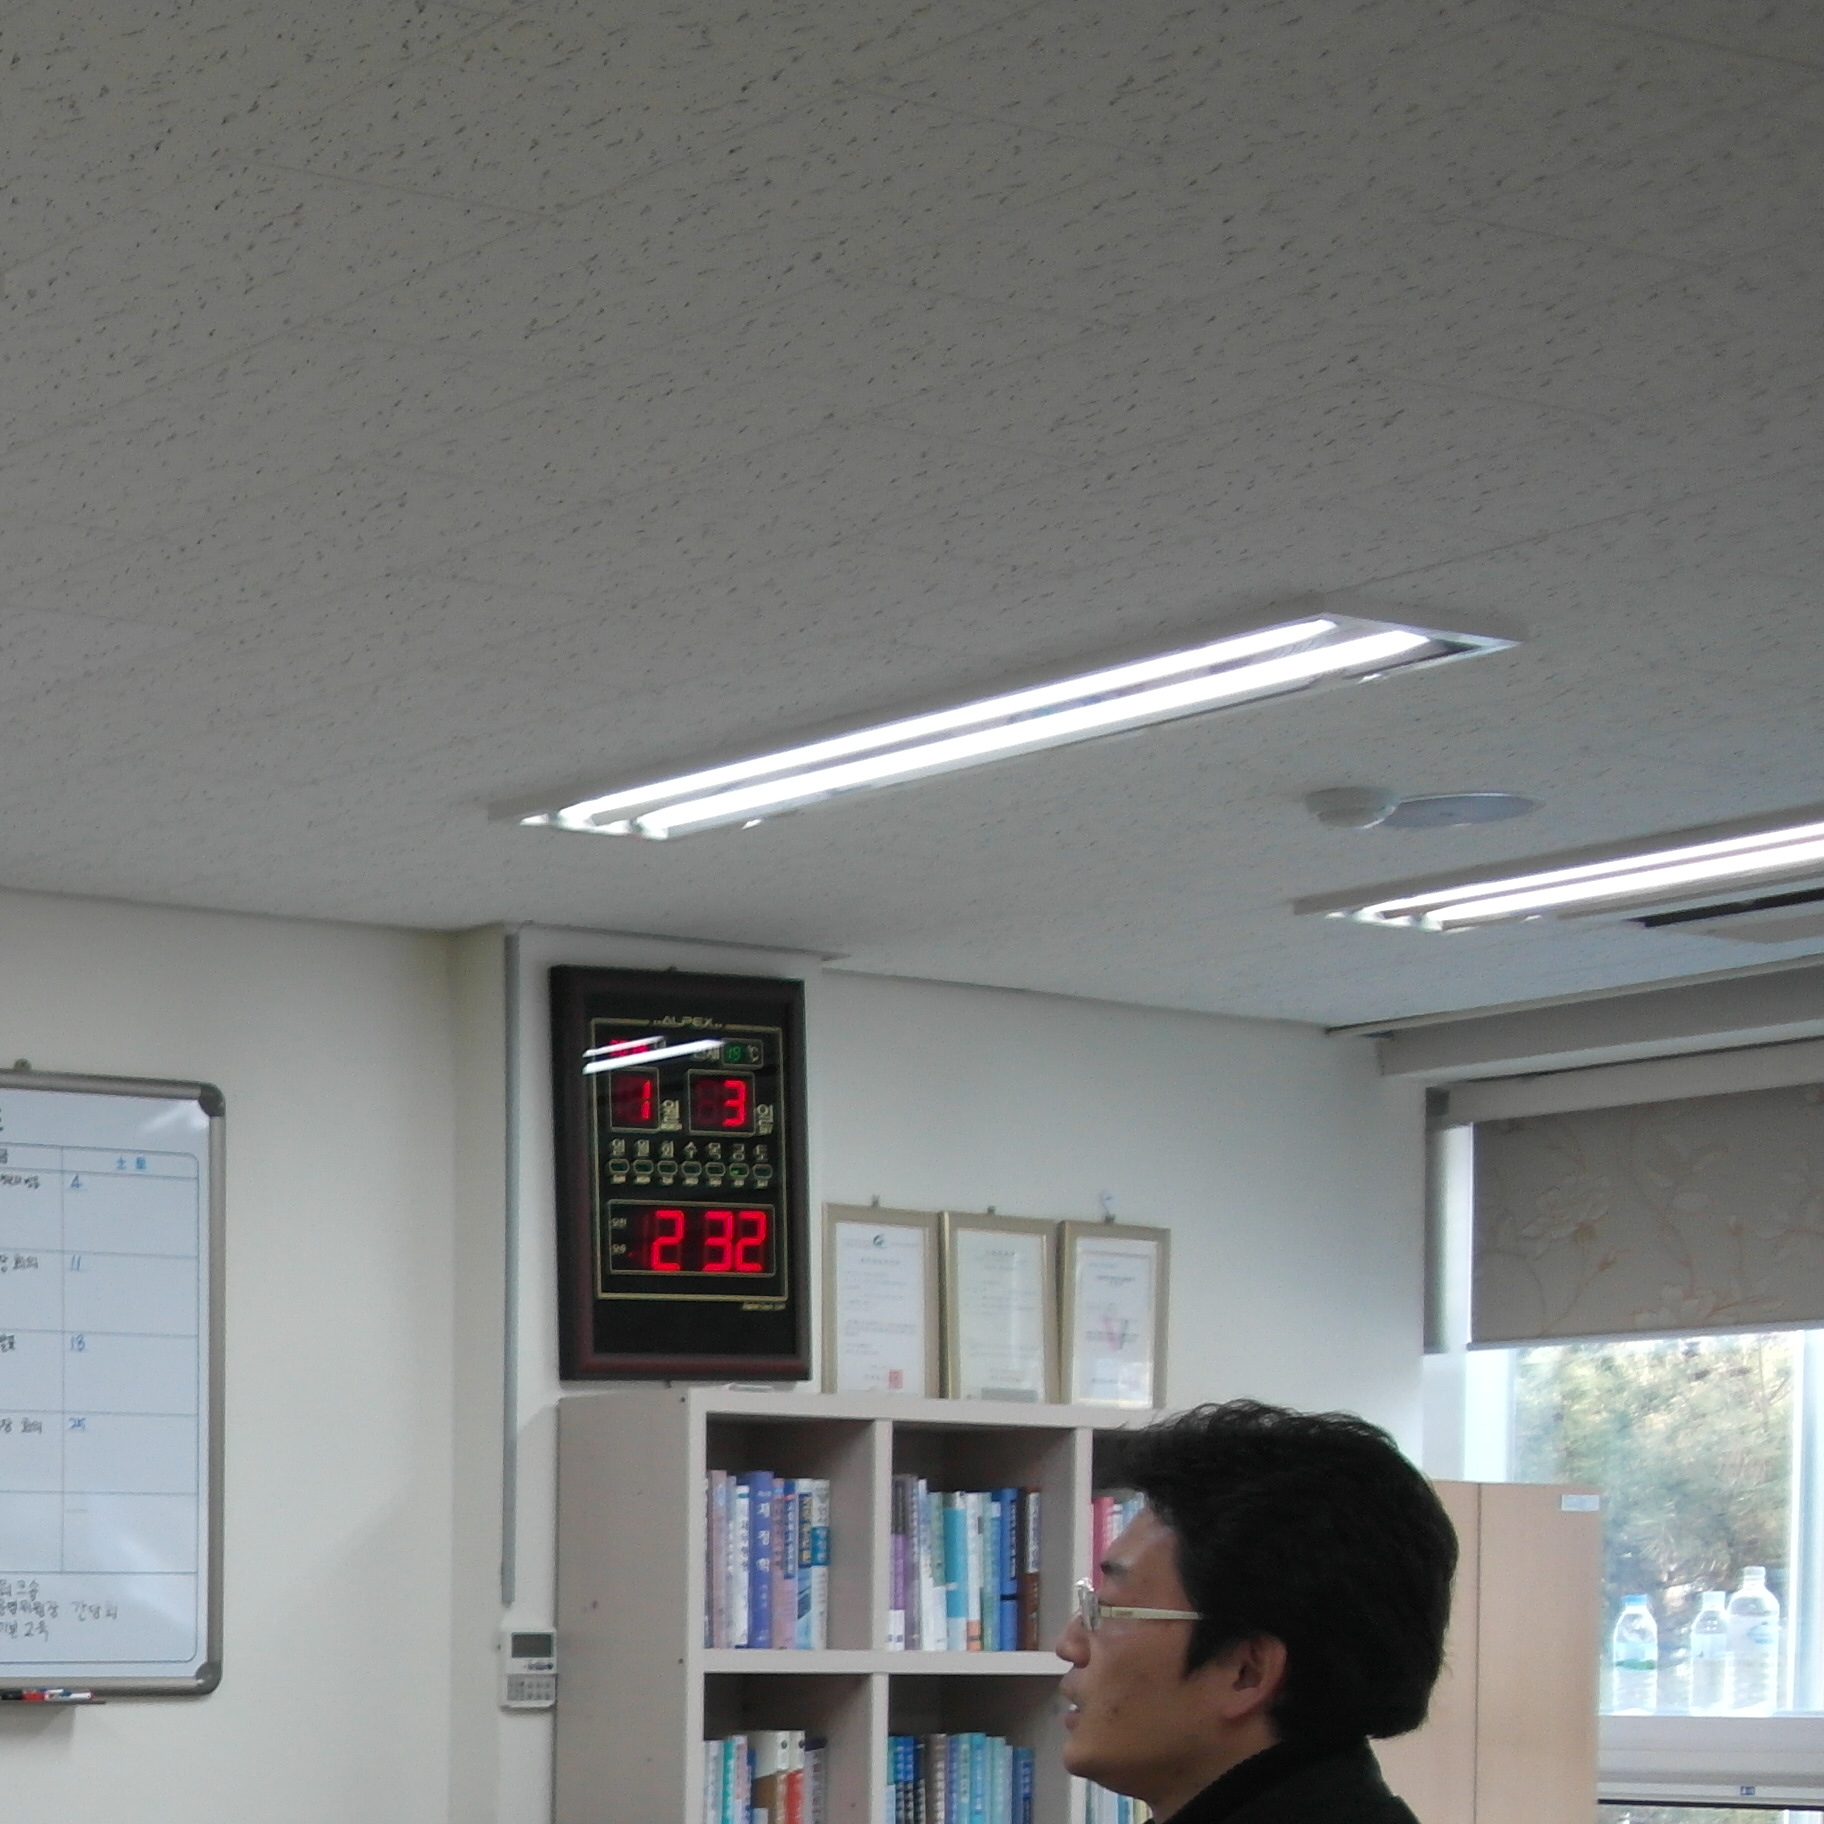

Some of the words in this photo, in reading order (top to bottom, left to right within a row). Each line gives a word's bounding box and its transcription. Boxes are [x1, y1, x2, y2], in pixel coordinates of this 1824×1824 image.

[640, 1080, 652, 1120] 1
[660, 1100, 681, 1124] 월
[723, 1079, 747, 1127] 3
